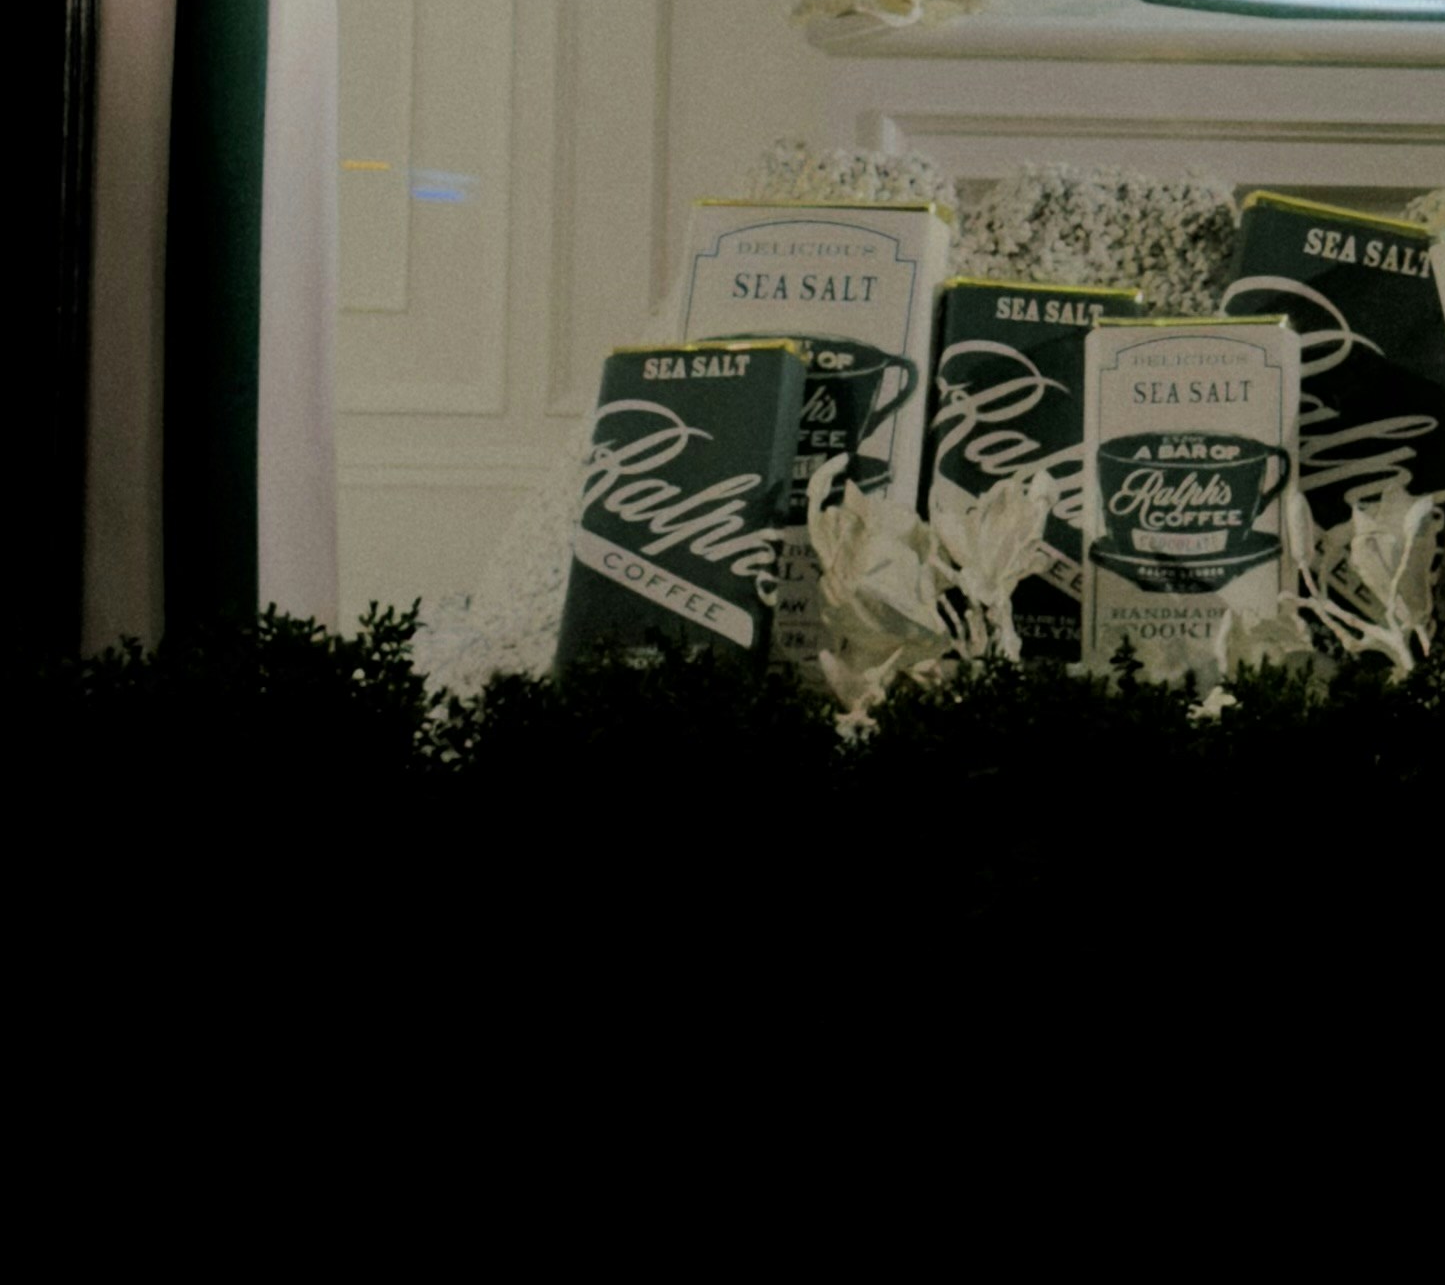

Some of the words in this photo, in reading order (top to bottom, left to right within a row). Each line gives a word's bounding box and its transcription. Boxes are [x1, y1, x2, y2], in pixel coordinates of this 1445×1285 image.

[736, 241, 877, 257] DELICIOUS
[1302, 227, 1357, 265] SEA
[1362, 237, 1435, 280] SALT
[732, 272, 789, 300] SEA
[799, 274, 878, 303] SALT
[996, 297, 1040, 322] SEA
[1044, 299, 1103, 326] SALT
[642, 357, 687, 380] SEA
[691, 354, 751, 379] SALT
[817, 352, 855, 370] OF
[1133, 381, 1180, 405] SEA
[1189, 381, 1253, 404] SALT
[1133, 445, 1153, 460] A
[1158, 444, 1207, 460] BAR
[1210, 445, 1241, 460] OF
[1109, 468, 1233, 530] Ralph's
[1149, 510, 1243, 527] COFFEE
[603, 552, 726, 623] COFFEE
